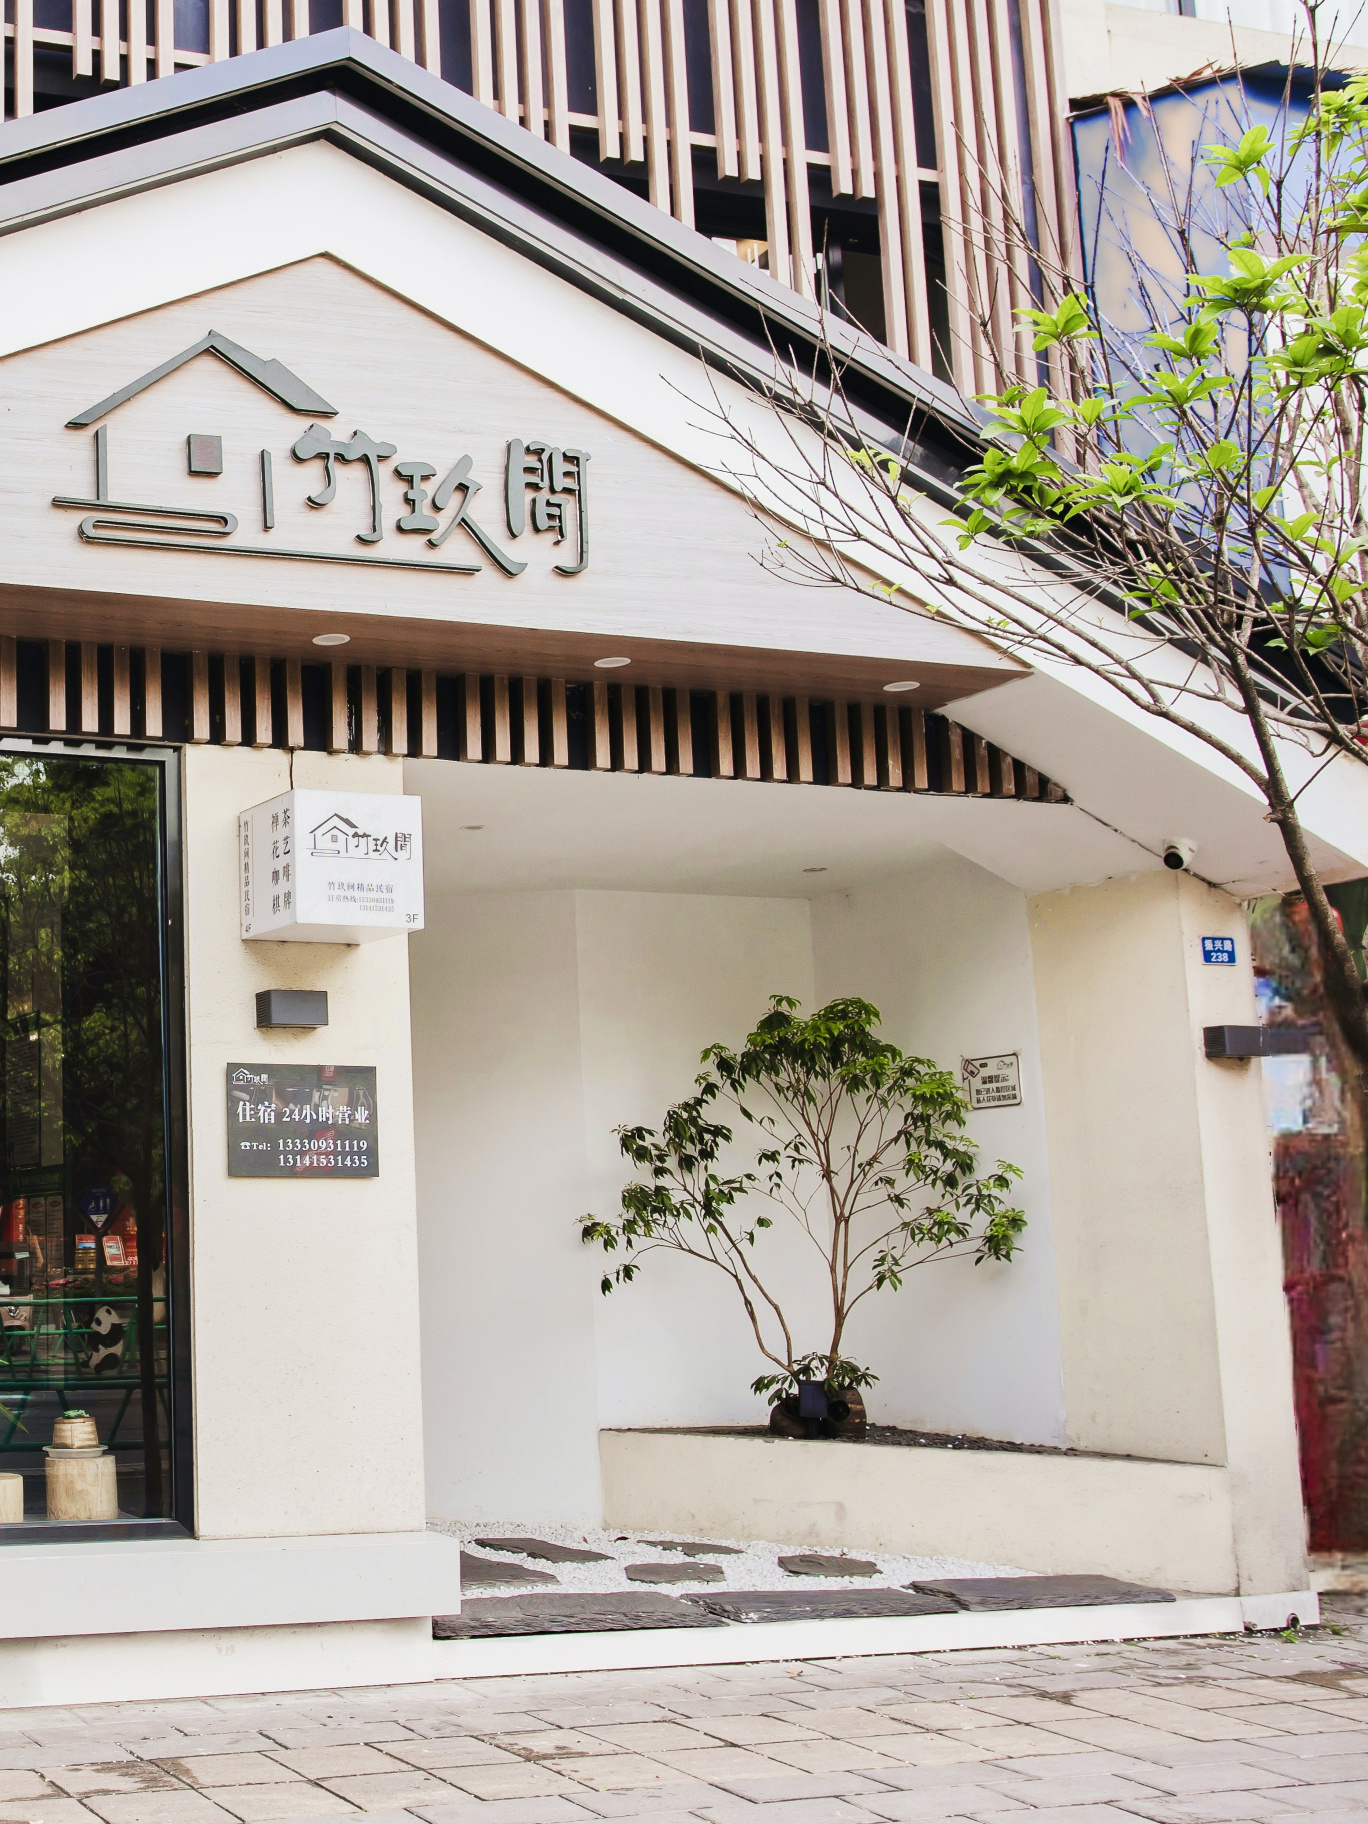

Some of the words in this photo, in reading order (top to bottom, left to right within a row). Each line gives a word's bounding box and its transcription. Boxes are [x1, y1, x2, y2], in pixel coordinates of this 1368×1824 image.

[290, 422, 591, 578] 竹玖間
[351, 831, 413, 861] 竹玖間
[327, 881, 394, 894] 竹玖间精品民宿
[405, 913, 419, 923] 3F
[1204, 938, 1233, 952] 振兴路
[1210, 952, 1229, 963] 238
[236, 1101, 277, 1124] 住宿
[282, 1105, 370, 1125] 24小时营业
[277, 1138, 368, 1152] 13330931119
[278, 1154, 368, 1167] 13141531435
